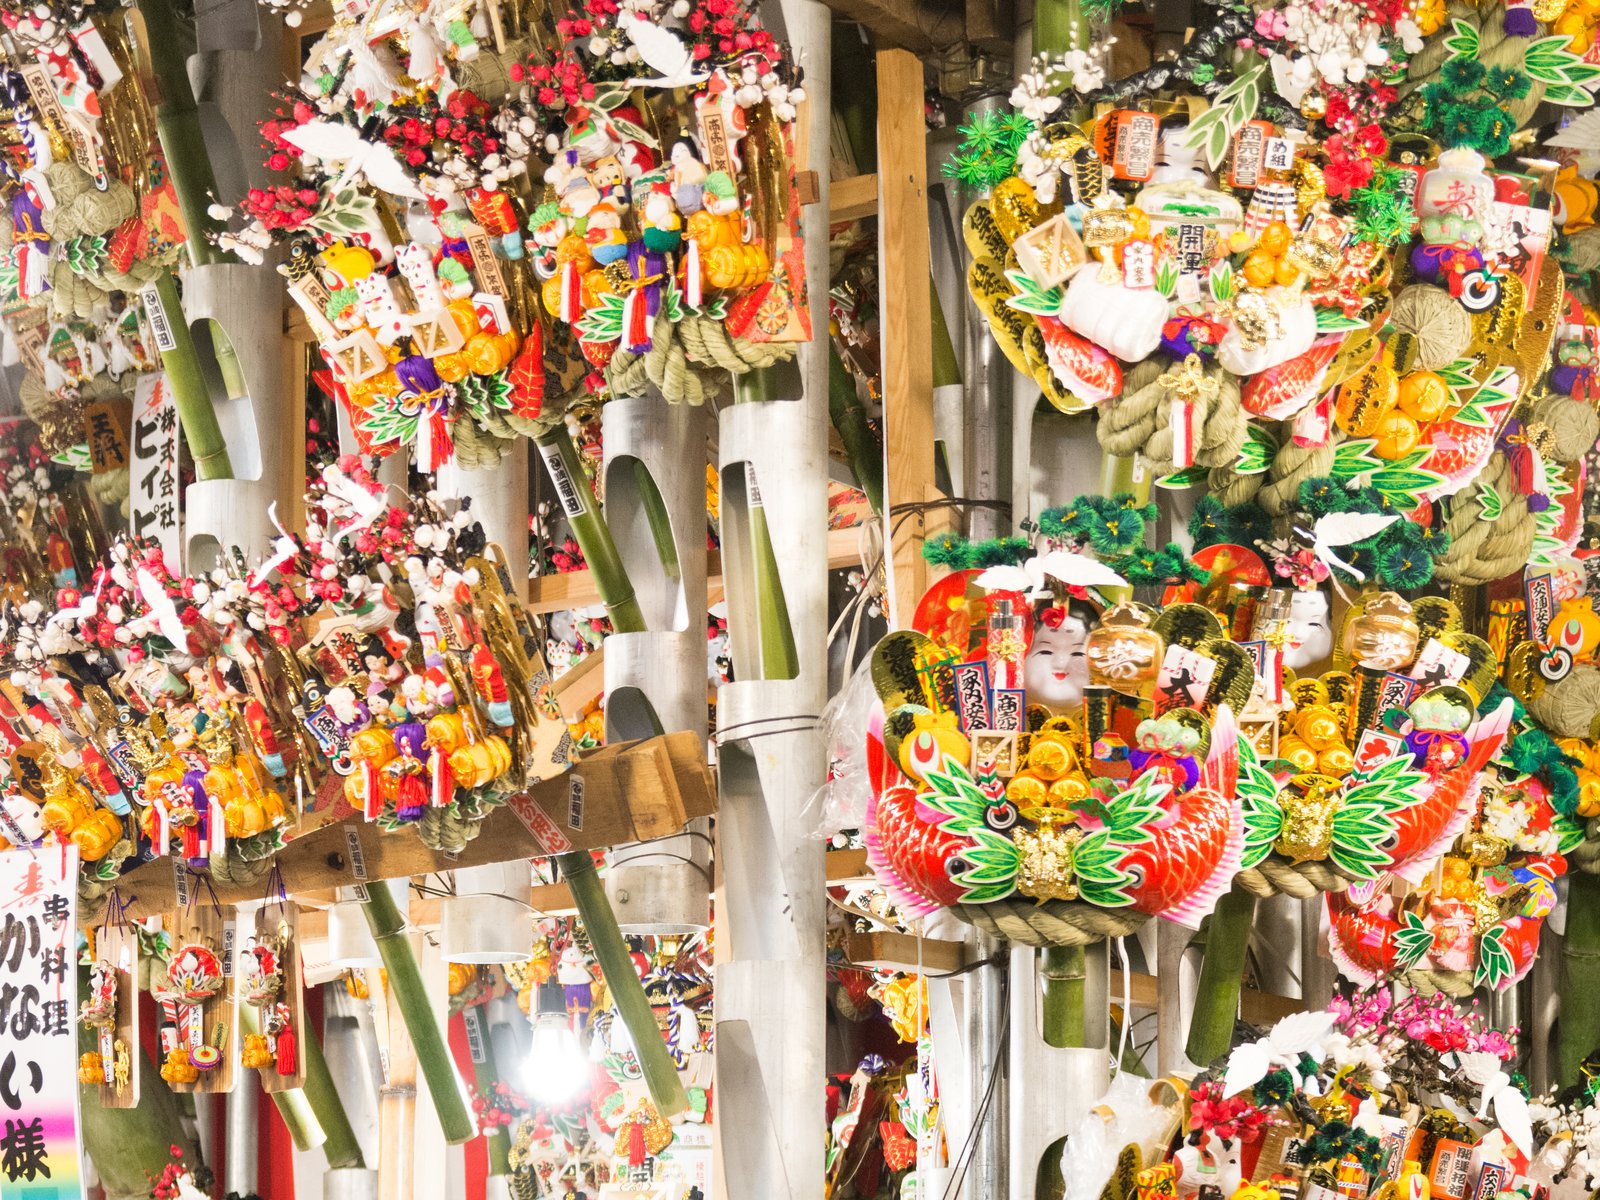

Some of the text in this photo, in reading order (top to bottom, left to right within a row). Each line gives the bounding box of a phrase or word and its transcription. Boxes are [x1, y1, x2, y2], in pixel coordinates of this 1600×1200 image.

[1269, 141, 1287, 168] め組
[1176, 224, 1206, 278] 開運
[159, 407, 177, 530] 株式会社
[41, 894, 71, 1037] 串料理
[0, 912, 52, 1183] かない様
[1448, 1147, 1472, 1197] 開運招福
